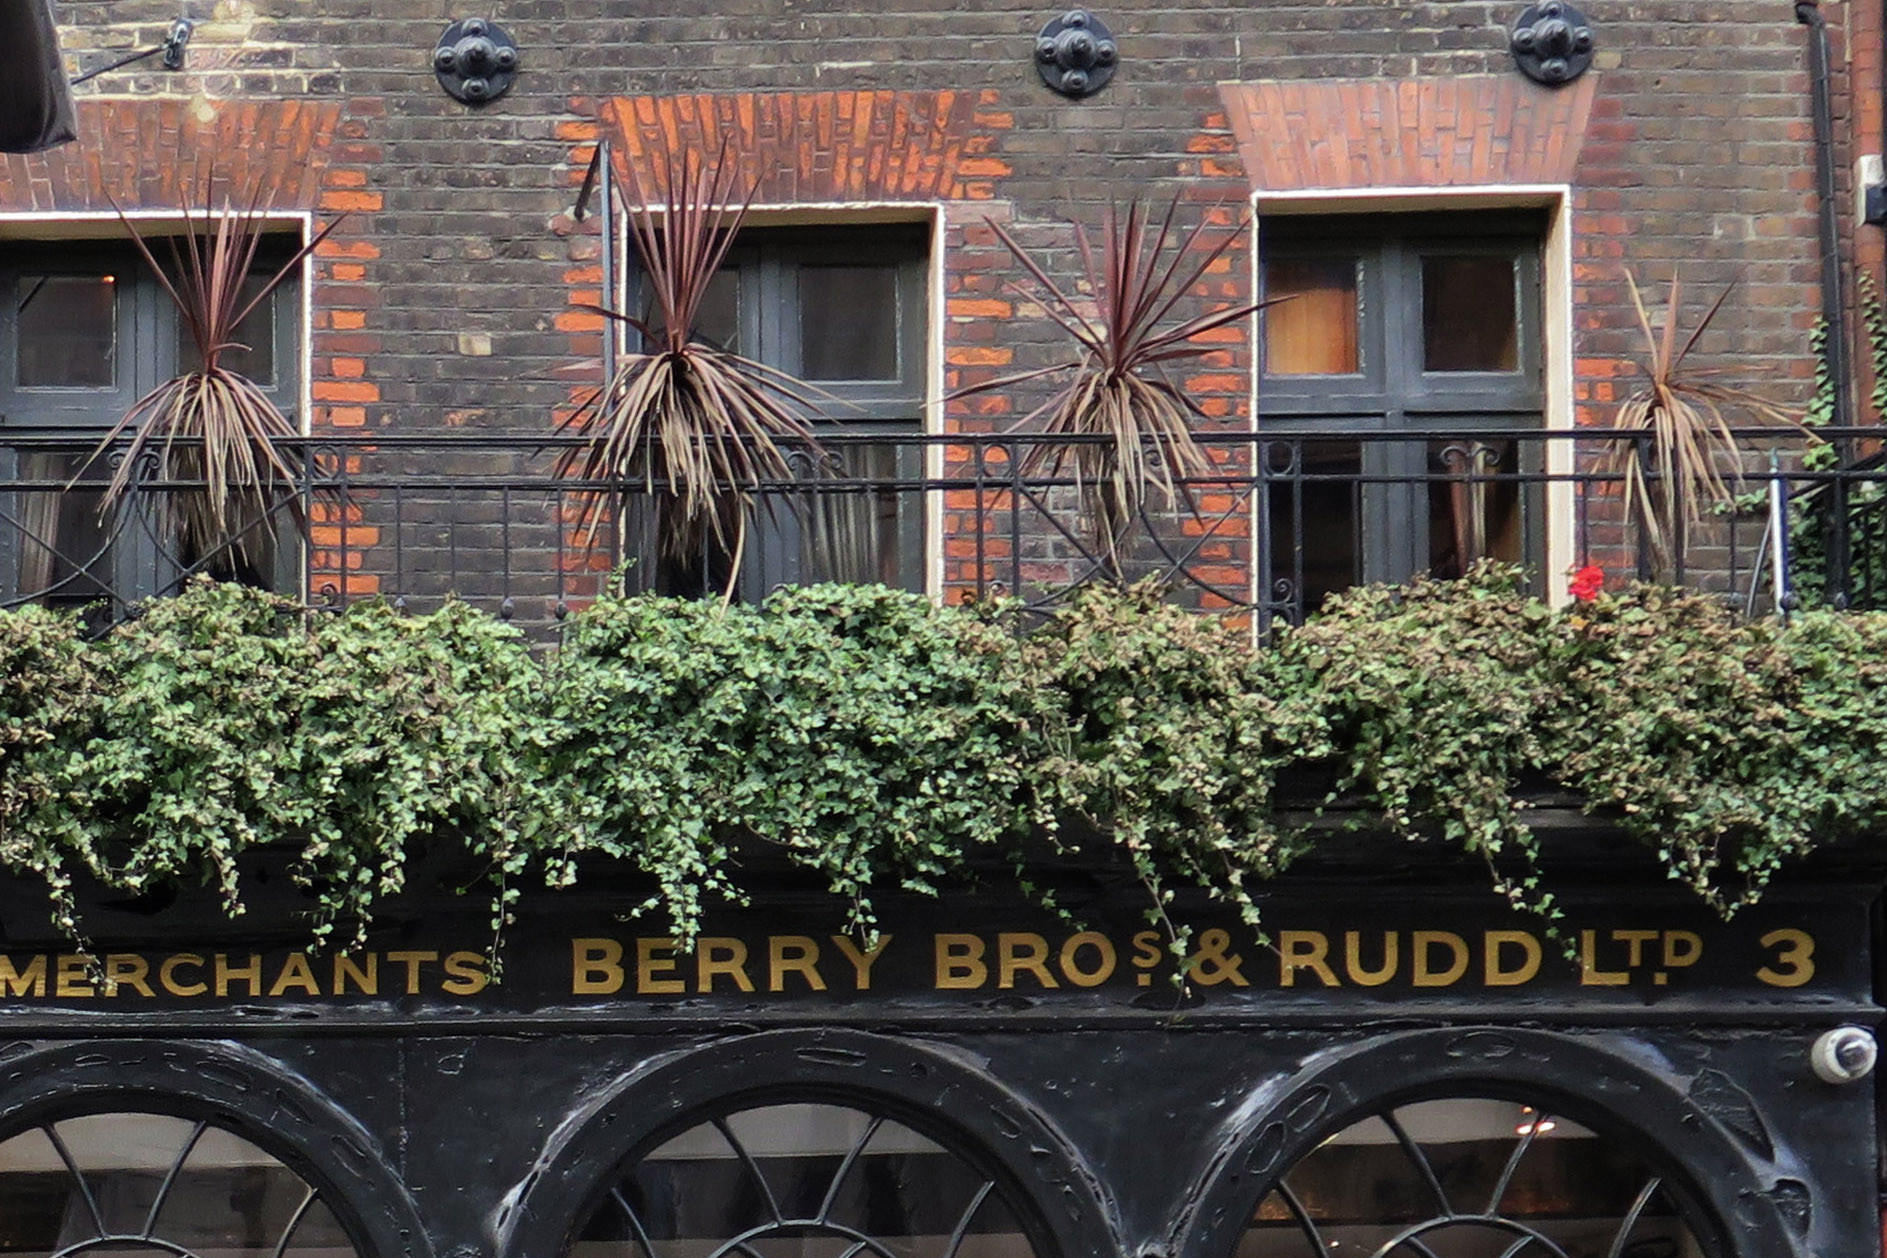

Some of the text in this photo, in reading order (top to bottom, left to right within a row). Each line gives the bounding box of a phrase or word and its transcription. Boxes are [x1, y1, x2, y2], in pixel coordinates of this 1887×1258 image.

[573, 936, 891, 994] BERRY
[1190, 929, 1249, 986] &
[1280, 931, 1541, 986] RUDD
[1756, 930, 1815, 987] 3
